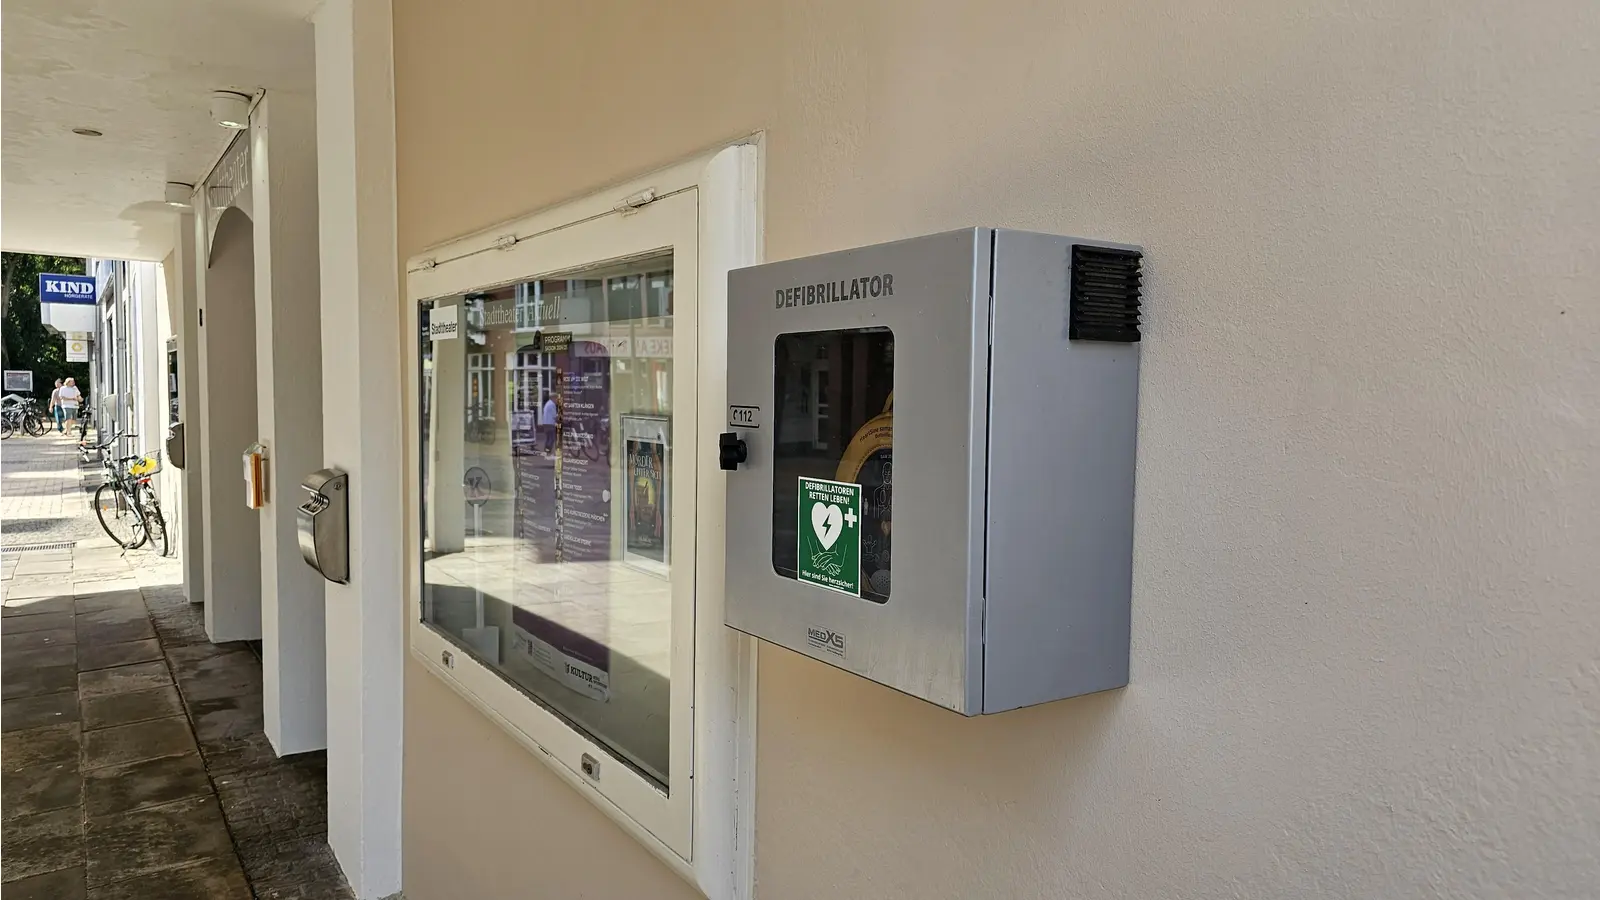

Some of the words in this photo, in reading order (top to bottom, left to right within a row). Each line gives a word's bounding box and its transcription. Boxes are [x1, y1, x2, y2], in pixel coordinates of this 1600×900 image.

[45, 280, 94, 294] KIND
[775, 273, 894, 309] DEFIBRILLATOR
[431, 321, 458, 335] Stadttheater
[738, 410, 753, 422] 112
[805, 481, 855, 497] DEFIBRILLATOREN
[808, 491, 829, 502] RETTEN
[830, 494, 850, 505] LEBEN!
[801, 569, 812, 578] Hier
[811, 572, 822, 581] sind
[821, 574, 829, 583] Sie
[828, 576, 854, 590] herzsicher!
[570, 665, 593, 683] KULTUR
